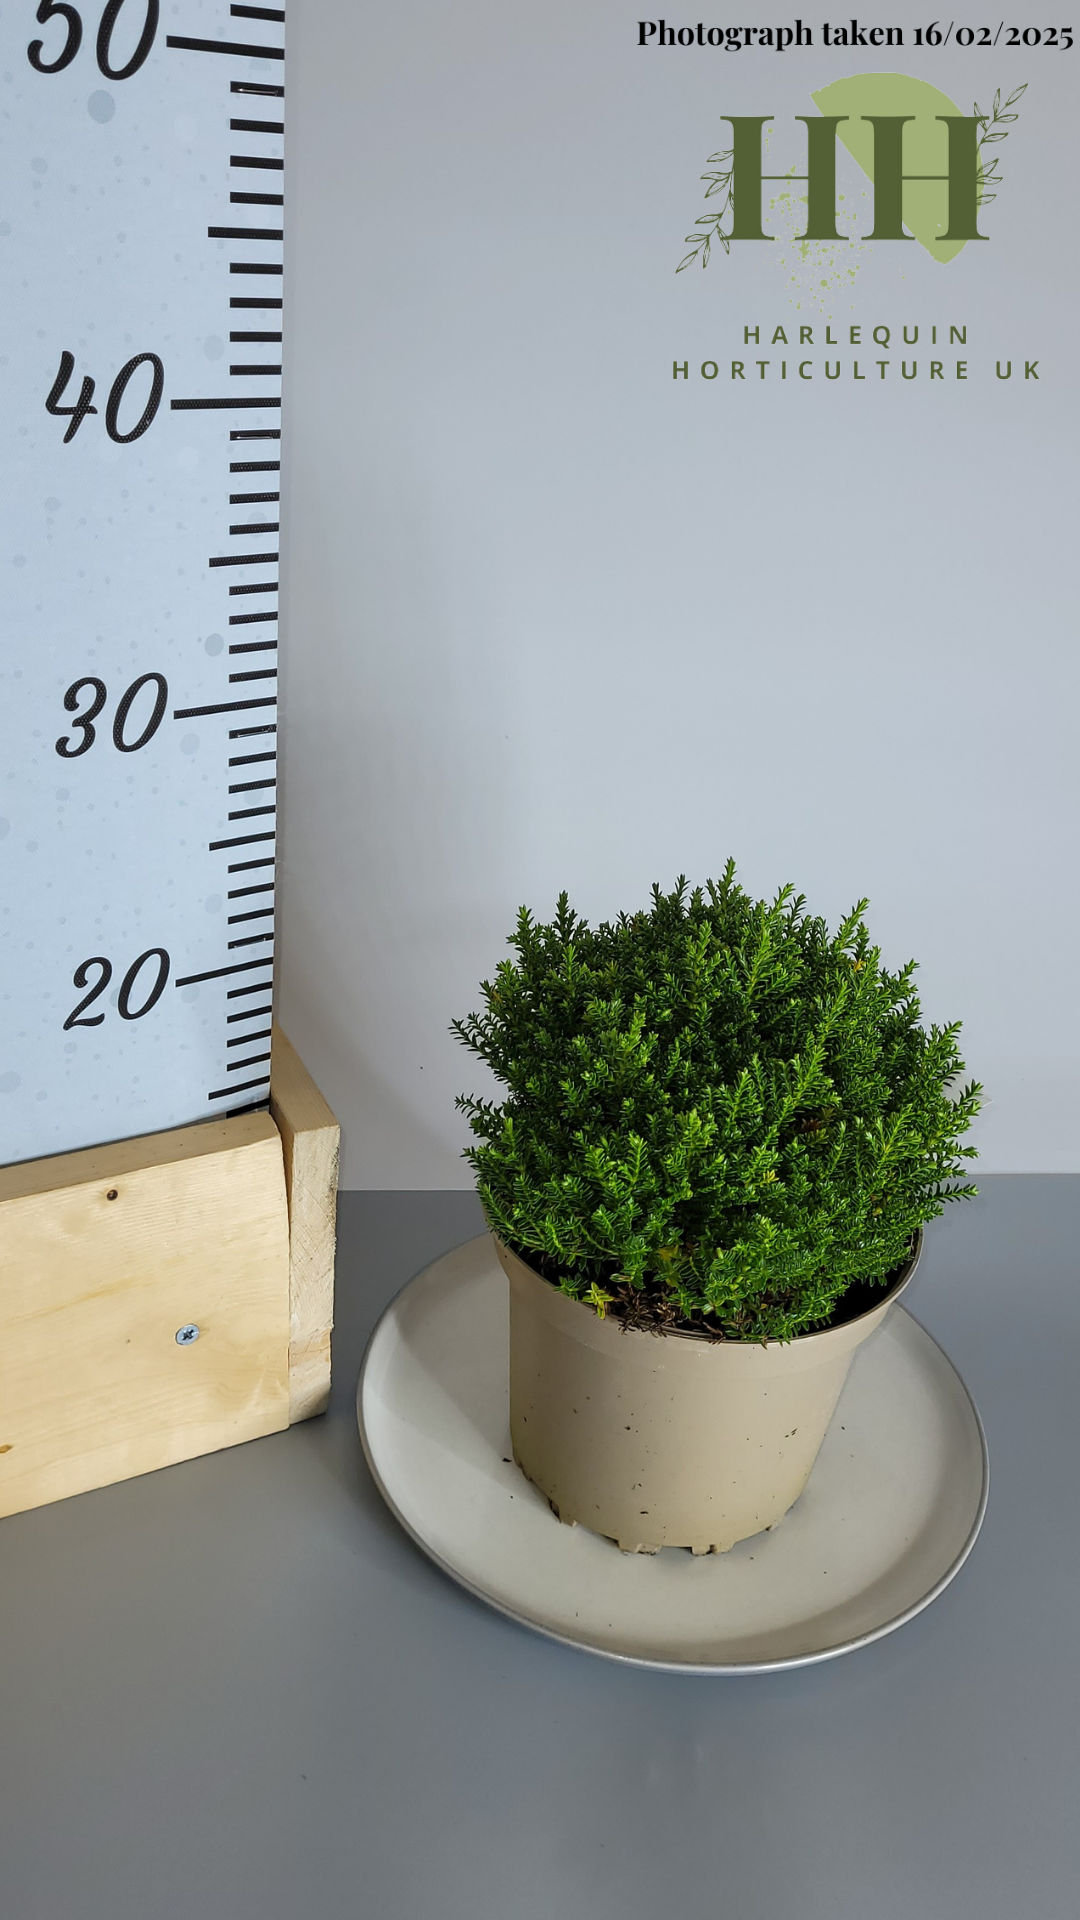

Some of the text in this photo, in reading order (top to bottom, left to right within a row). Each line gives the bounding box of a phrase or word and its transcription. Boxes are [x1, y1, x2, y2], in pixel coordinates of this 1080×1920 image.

[27, 0, 160, 81] 50
[45, 350, 165, 444] 40
[55, 672, 168, 758] 30
[62, 947, 171, 1031] 20
